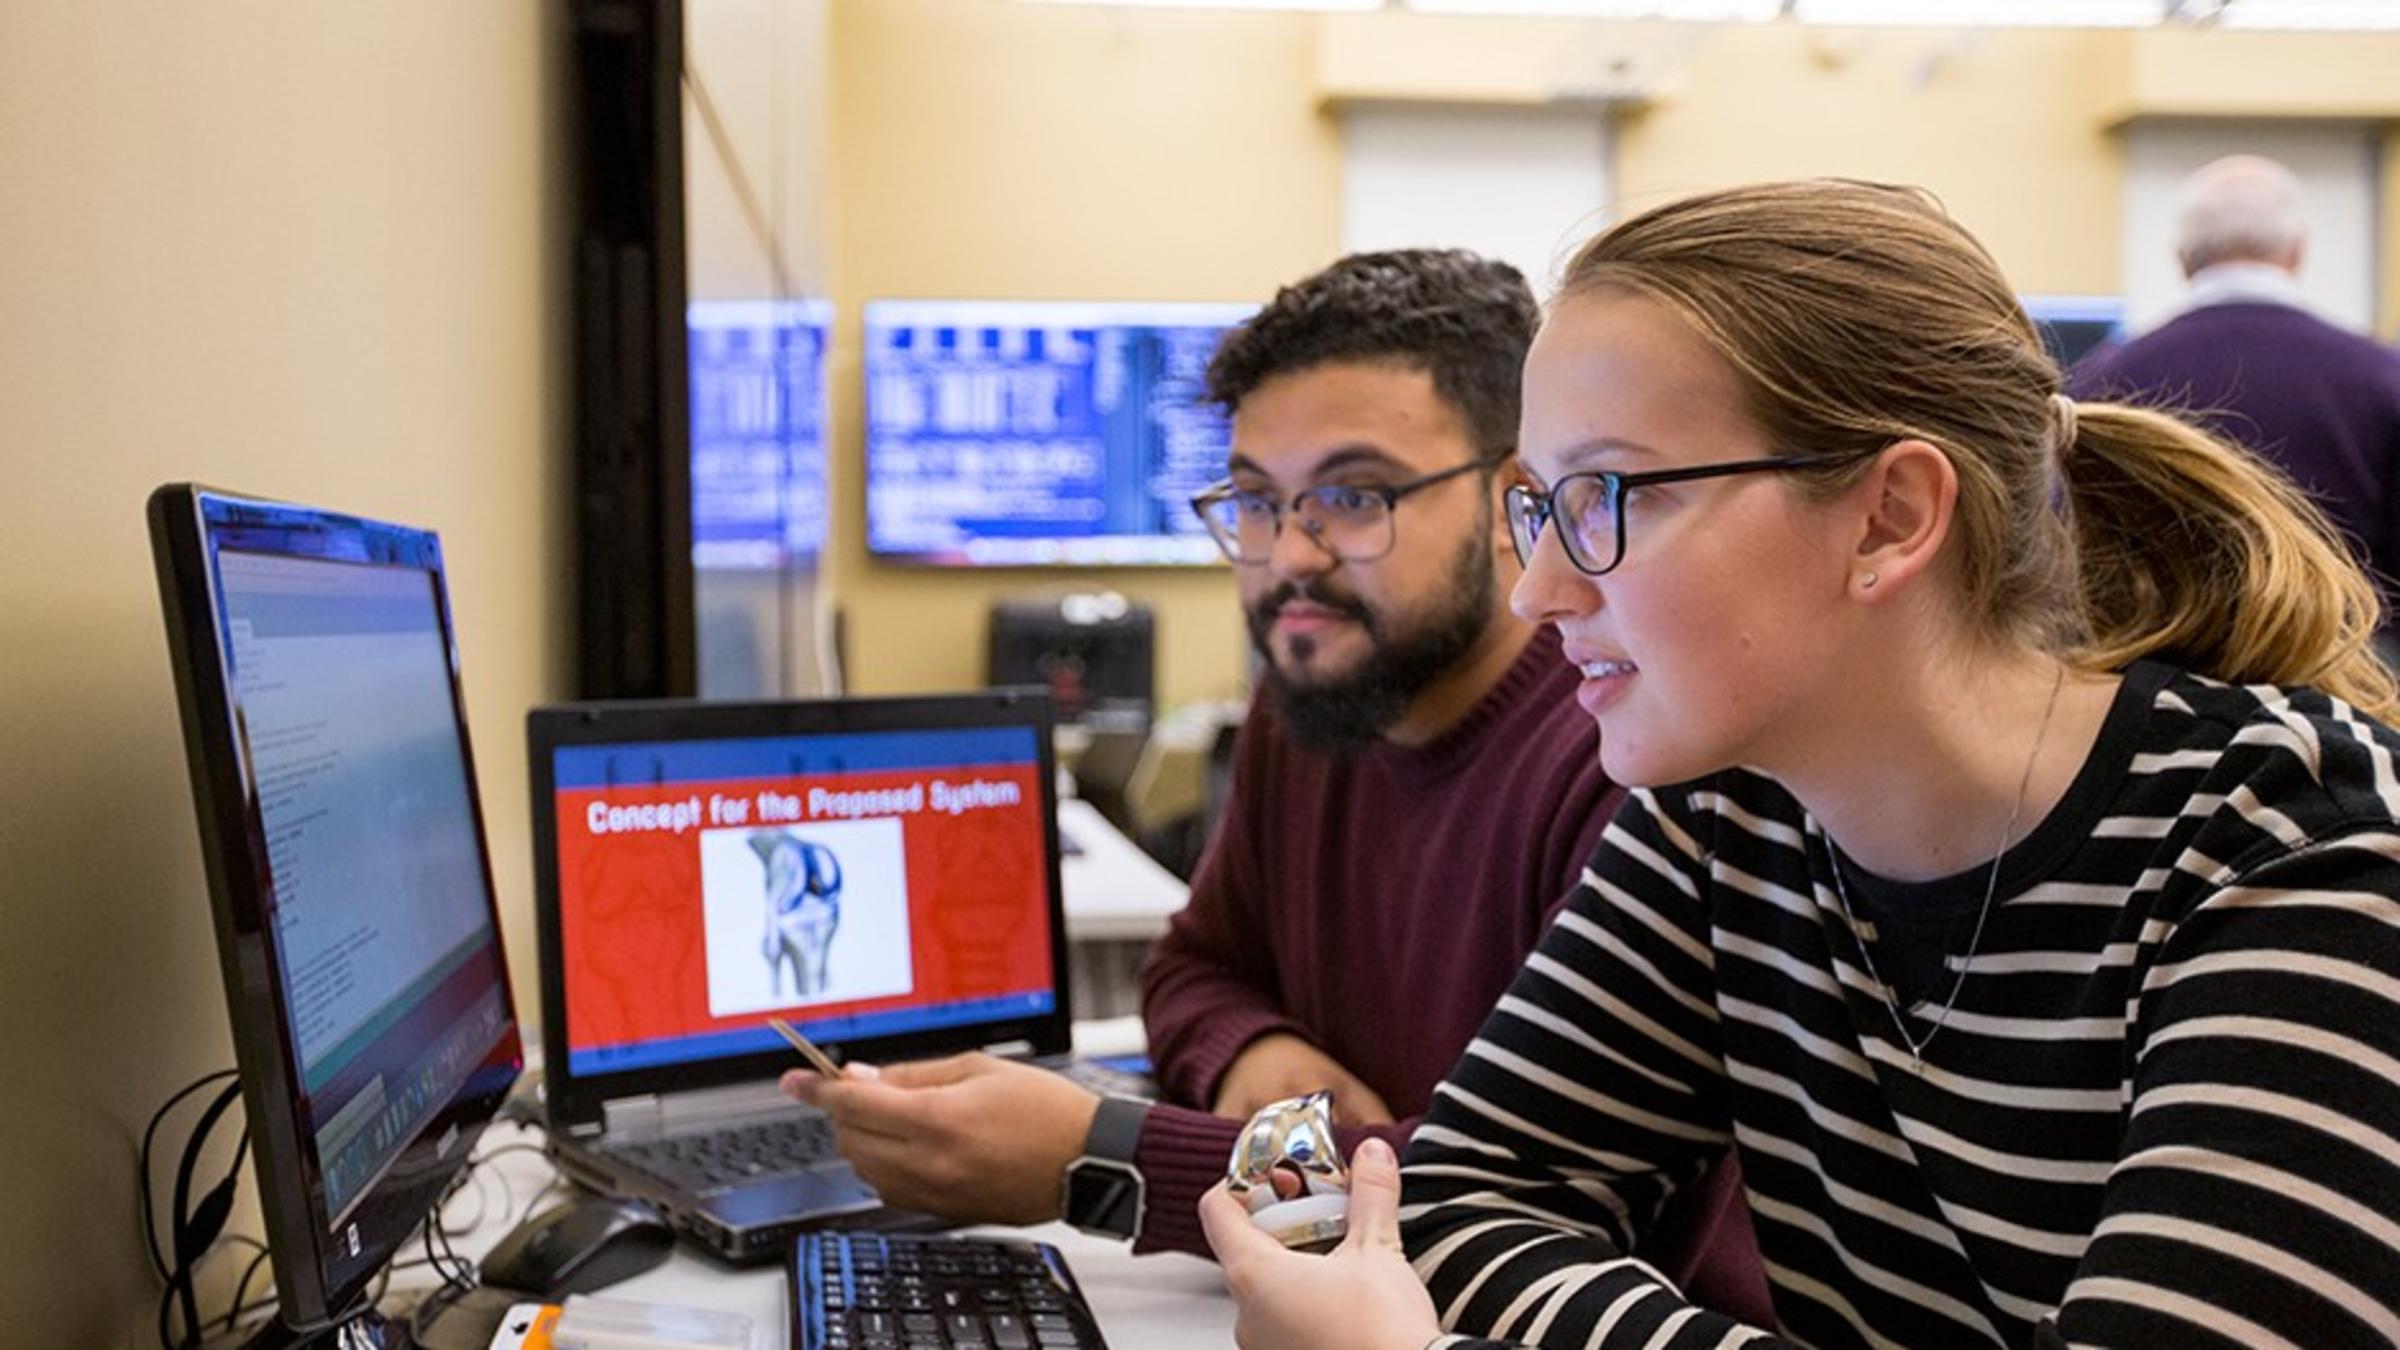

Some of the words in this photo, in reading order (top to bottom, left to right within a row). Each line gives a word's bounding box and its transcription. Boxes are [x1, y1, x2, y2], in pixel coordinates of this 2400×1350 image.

[588, 796, 700, 834] Concept
[709, 794, 748, 825] for
[757, 791, 800, 821] the
[808, 782, 923, 818] Proposed
[930, 779, 1020, 815] System
